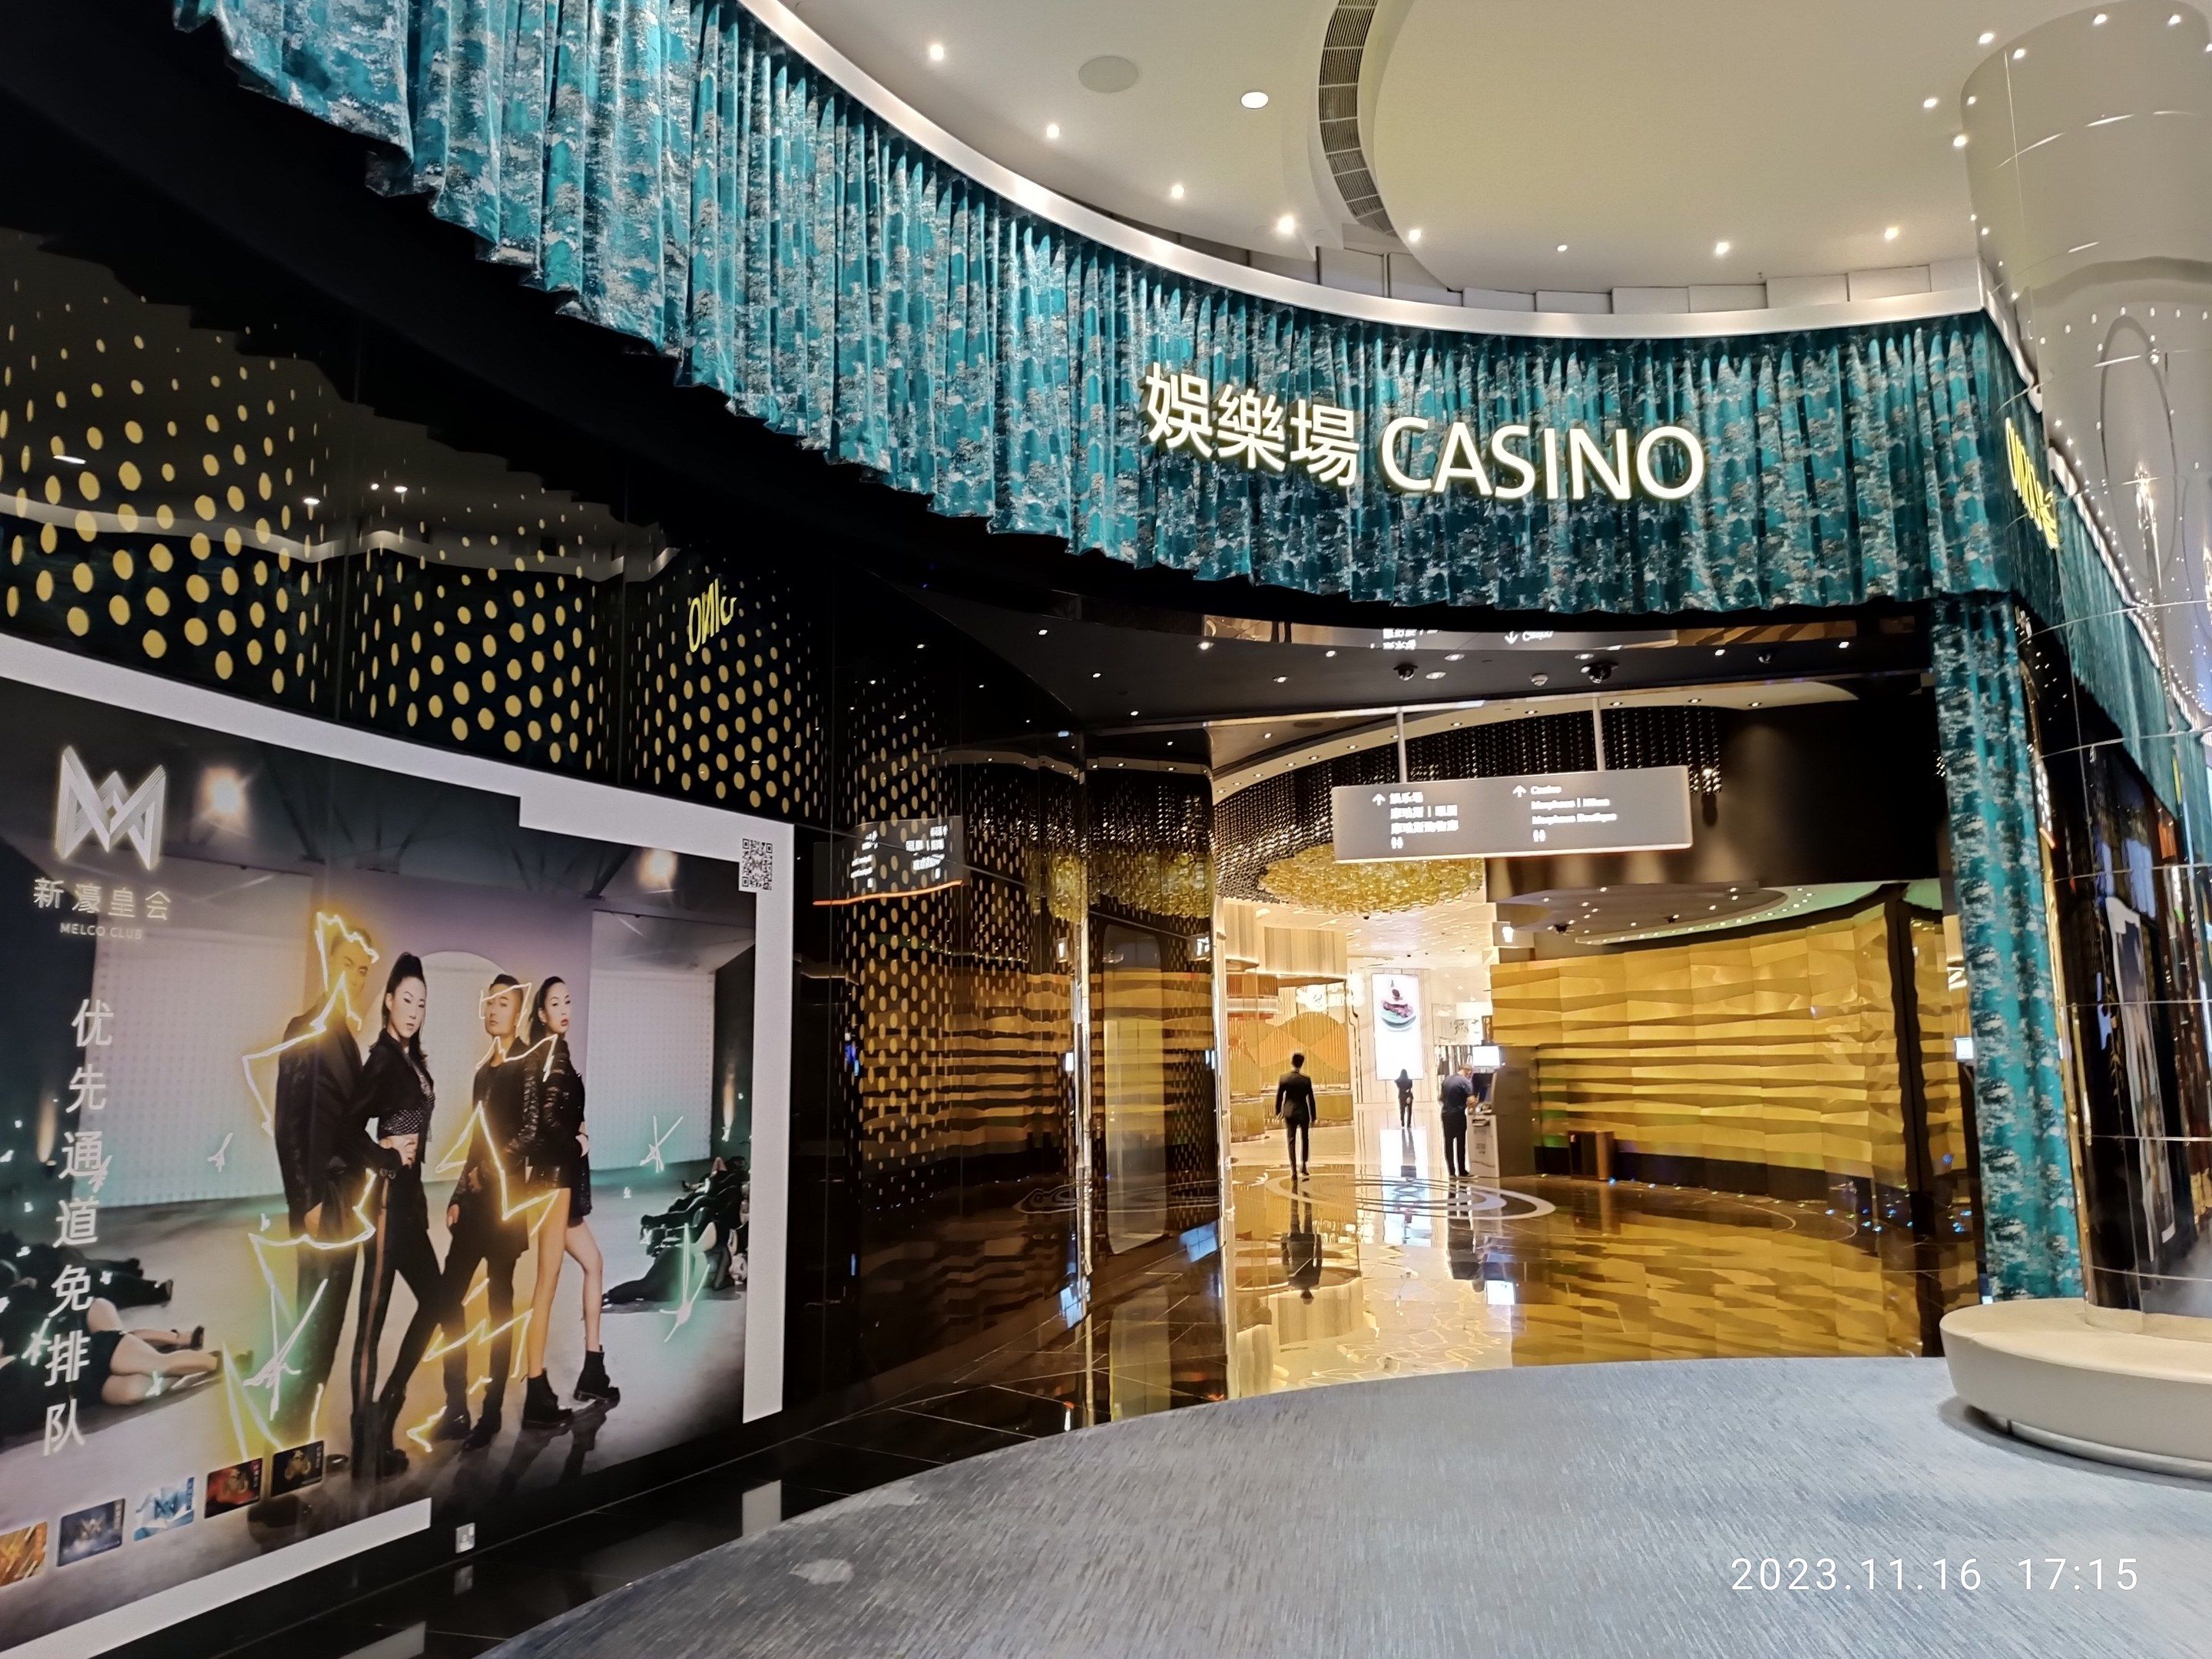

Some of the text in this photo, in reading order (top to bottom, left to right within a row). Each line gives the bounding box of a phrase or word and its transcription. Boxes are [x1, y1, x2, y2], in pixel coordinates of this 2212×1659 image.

[1382, 417, 1703, 500] CASINO
[33, 877, 171, 920] 新濠皇会
[60, 922, 142, 939] MELCO CLUB
[43, 998, 114, 1456] 优先通道免排队
